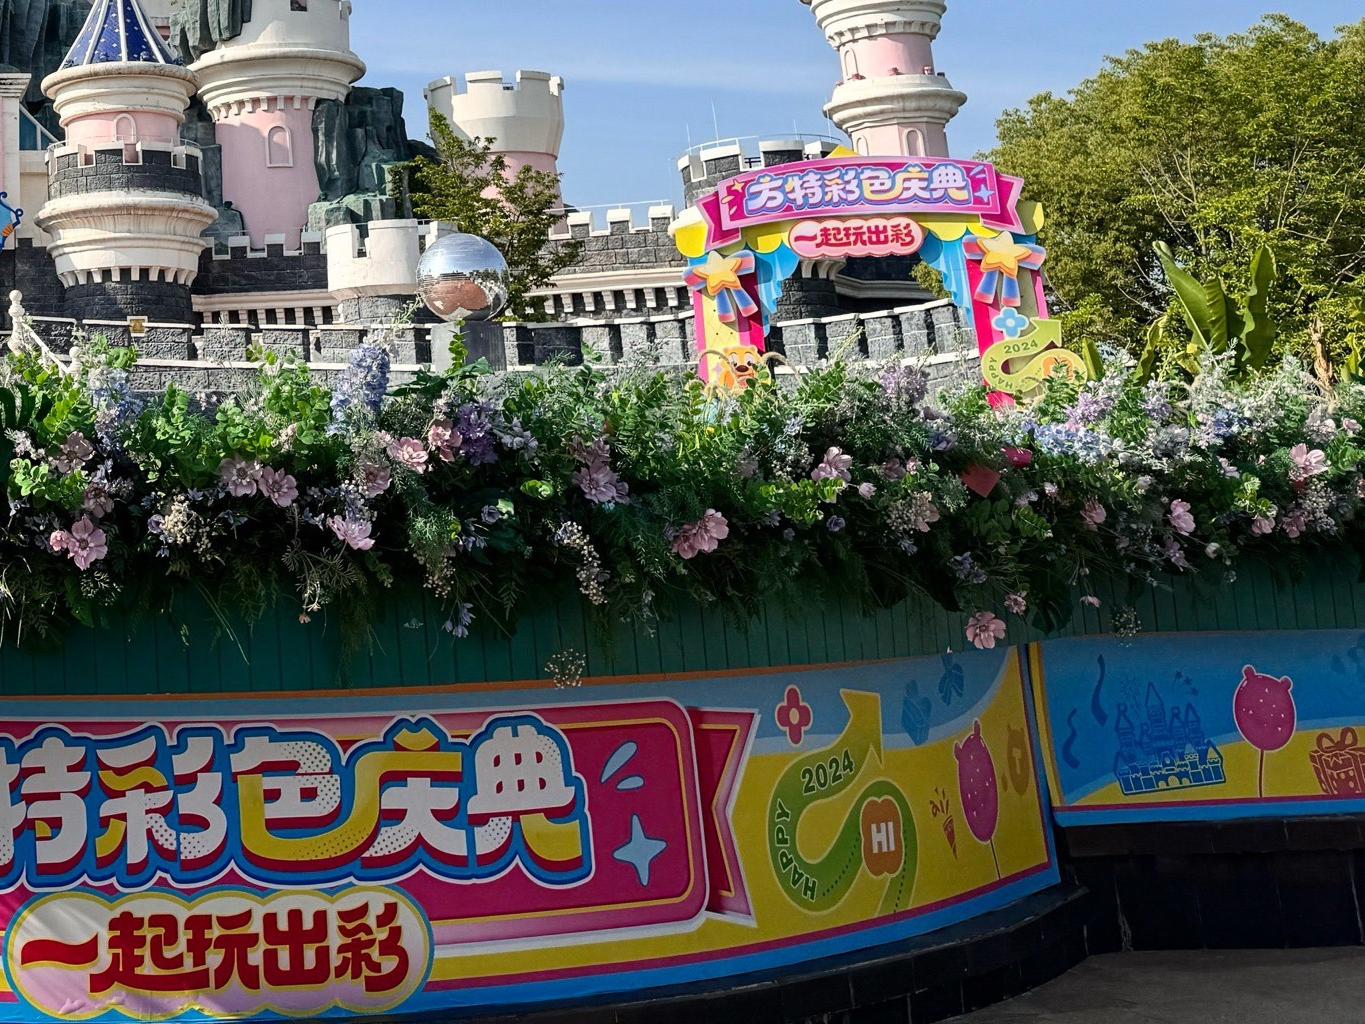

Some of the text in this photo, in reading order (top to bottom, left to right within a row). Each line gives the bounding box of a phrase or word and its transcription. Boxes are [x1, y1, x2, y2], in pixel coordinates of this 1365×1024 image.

[746, 164, 970, 213] 方特彩色庆典
[793, 224, 916, 246] 一起玩出彩
[1004, 340, 1038, 354] 2024
[988, 357, 1013, 389] HAPPY
[801, 749, 855, 796] 2024
[774, 799, 818, 902] HAPPY
[870, 821, 896, 854] HI
[21, 901, 409, 994] 一起玩出彩
